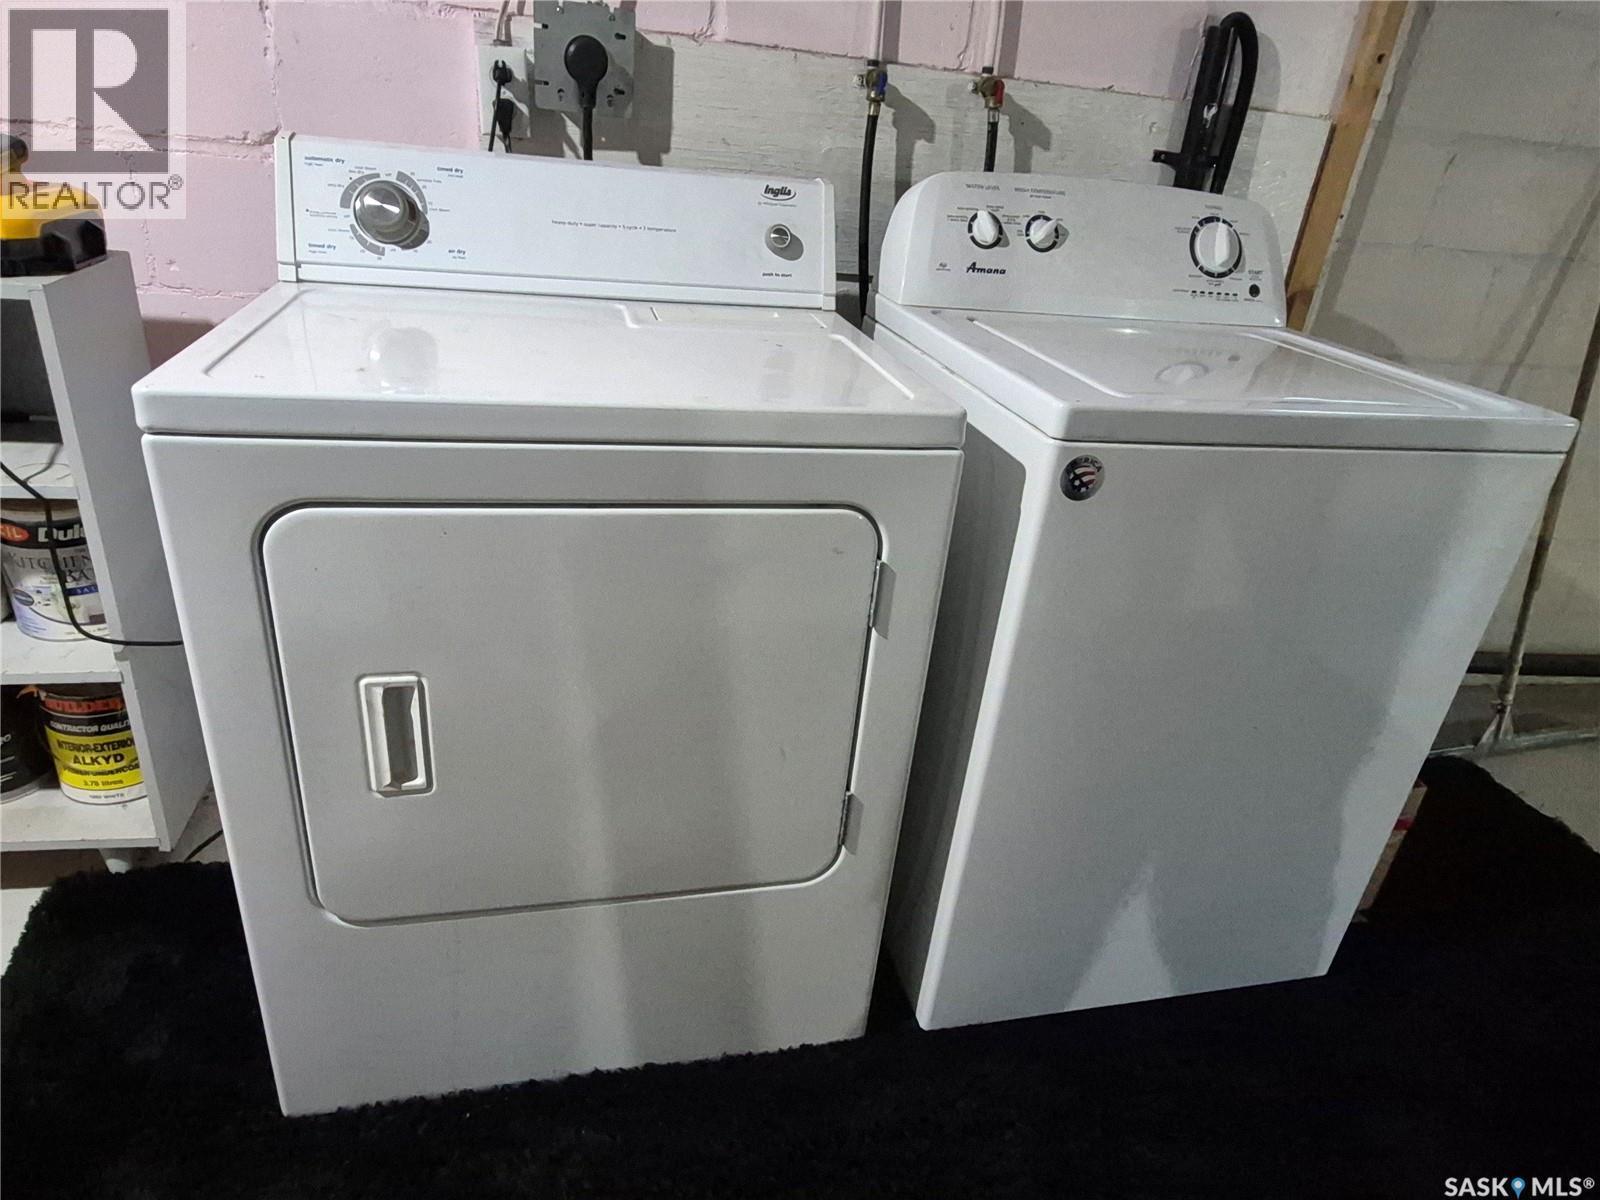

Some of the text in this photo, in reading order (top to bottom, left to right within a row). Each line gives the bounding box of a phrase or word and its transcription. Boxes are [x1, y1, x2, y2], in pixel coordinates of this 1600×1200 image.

[334, 157, 346, 165] dry
[763, 184, 793, 198] Inglis
[965, 261, 1006, 275] Amana
[72, 753, 126, 766] ALKYD
